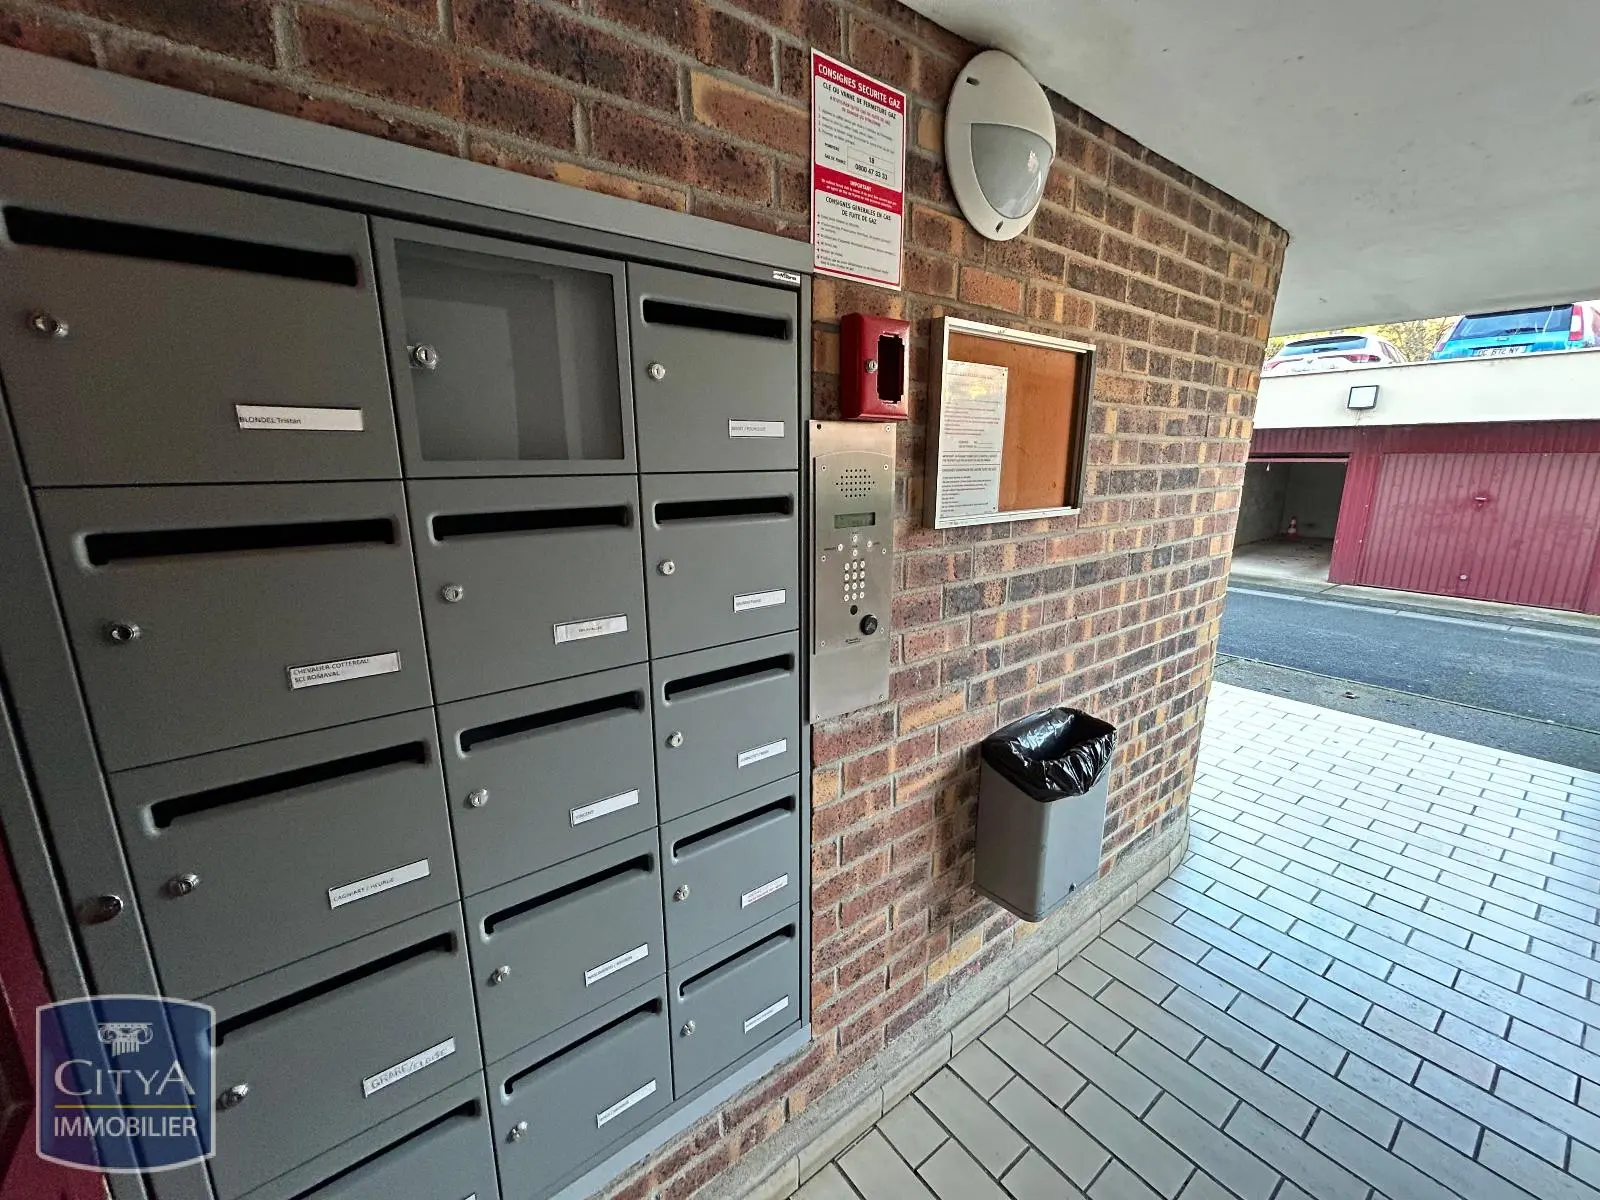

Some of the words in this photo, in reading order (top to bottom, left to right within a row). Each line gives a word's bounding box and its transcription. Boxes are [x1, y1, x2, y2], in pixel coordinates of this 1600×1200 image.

[818, 63, 857, 89] CONSIGNES
[857, 82, 888, 104] SECURITE
[888, 97, 901, 109] GAZ
[822, 82, 832, 92] CLE
[832, 86, 840, 95] OU
[840, 89, 856, 102] VANNE
[856, 97, 862, 105] DE
[863, 100, 887, 116] FERMETURE
[887, 111, 897, 120] GAZ
[868, 156, 875, 164] 18
[854, 163, 868, 173] 0800
[849, 180, 872, 192] IMPORTANT
[825, 196, 851, 209] CONSIGNES
[851, 204, 876, 217] GENERALES
[882, 213, 891, 221] CAS
[848, 211, 860, 220] FUITE
[868, 217, 877, 225] GAZ
[239, 416, 277, 424] BLONDEL
[306, 672, 341, 681] ROMAVAL
